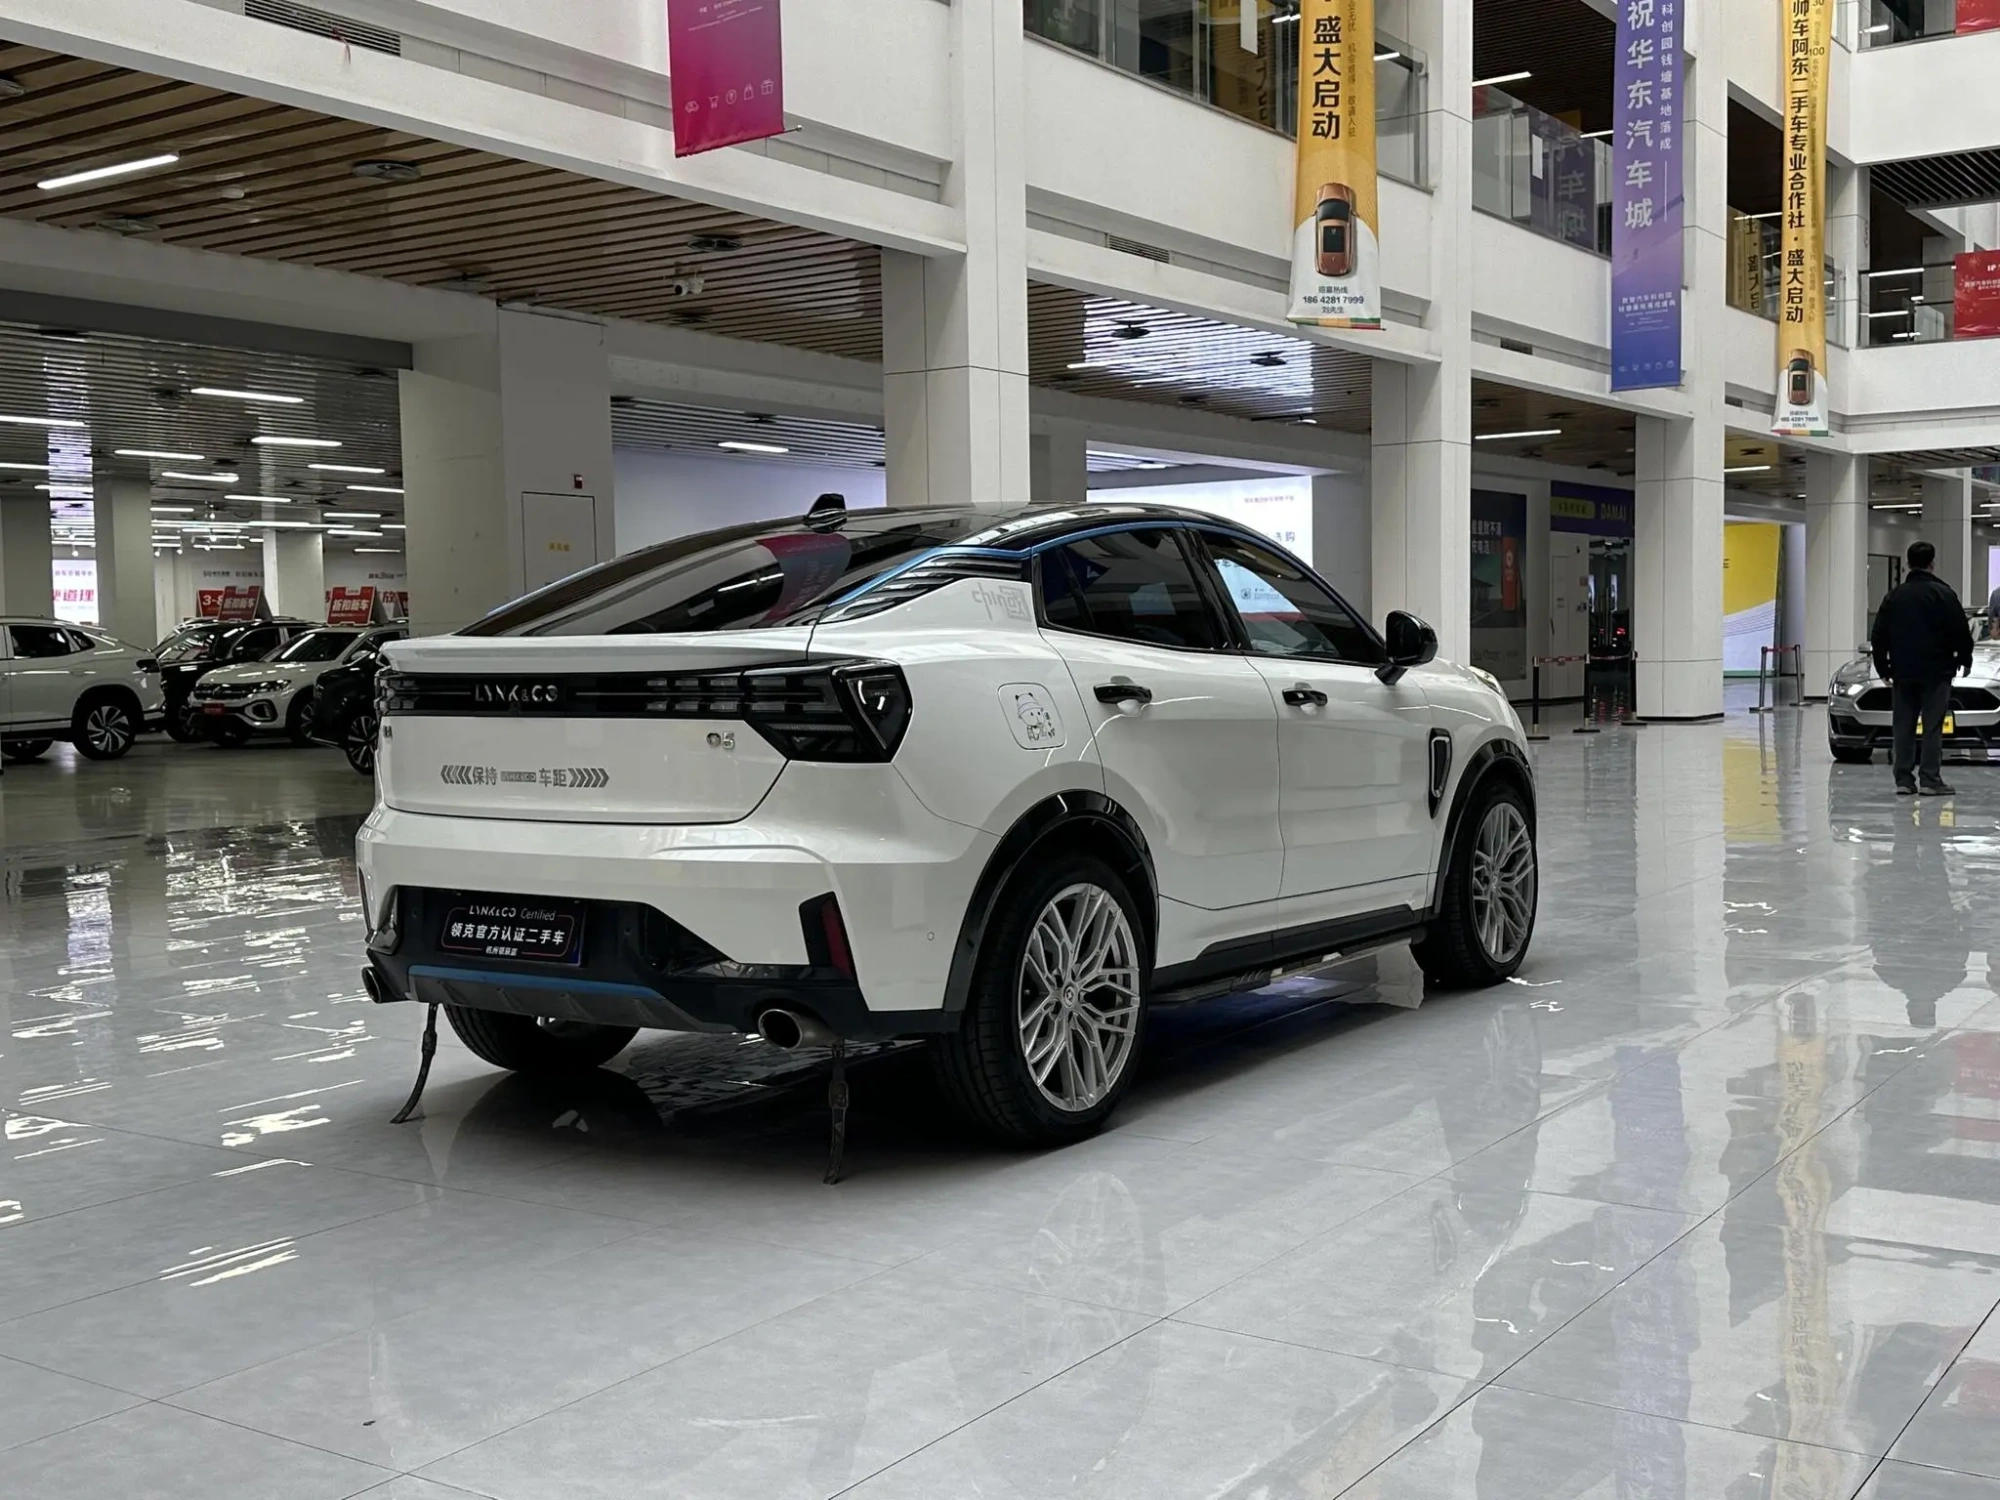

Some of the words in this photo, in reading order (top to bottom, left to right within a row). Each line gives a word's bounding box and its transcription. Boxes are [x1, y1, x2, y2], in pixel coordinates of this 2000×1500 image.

[1312, 15, 1341, 140] 盛大启动
[1625, 0, 1655, 229] 祝华东汽车城
[1303, 295, 1319, 304] 186
[1320, 295, 1341, 304] 4281
[1343, 295, 1364, 304] 7999
[332, 599, 370, 612] 折扣新车
[472, 766, 498, 786] 保持
[538, 767, 567, 787] 车距
[450, 922, 566, 946] 领克官方认证二手车
